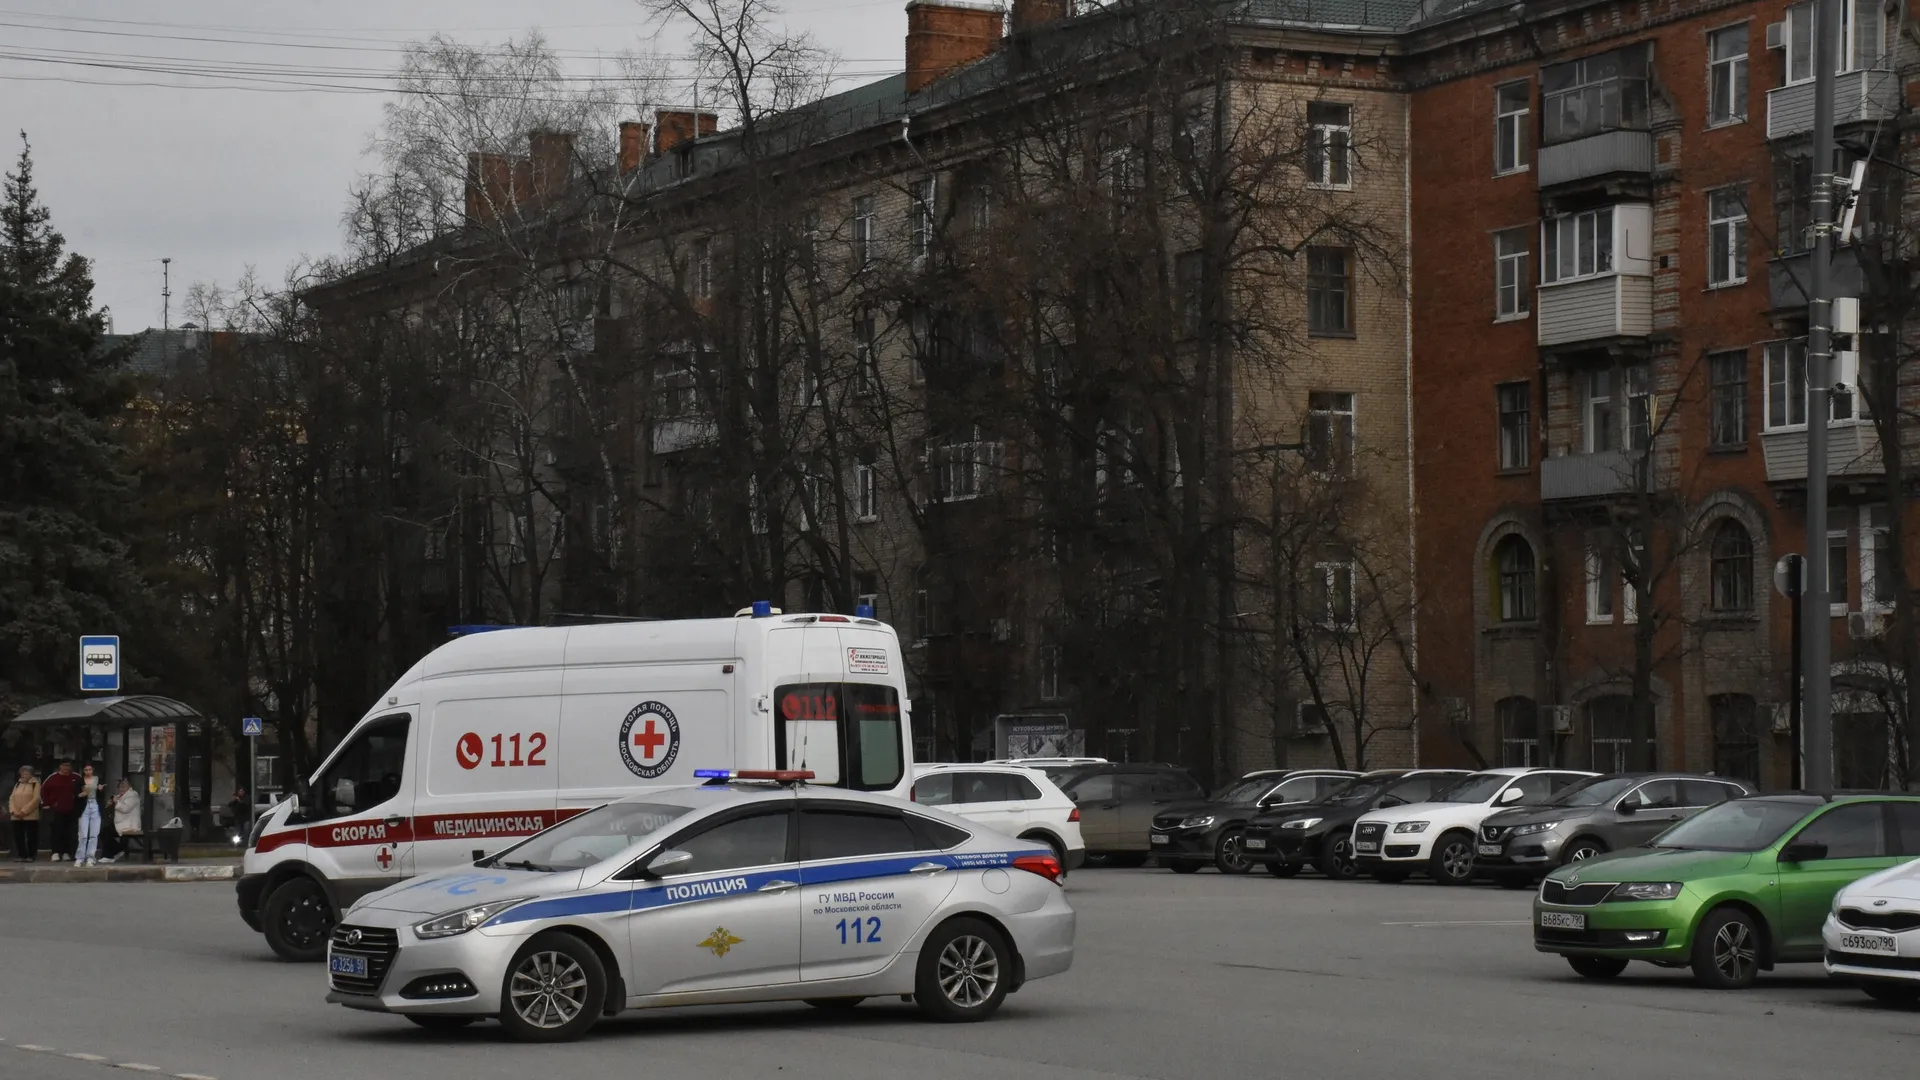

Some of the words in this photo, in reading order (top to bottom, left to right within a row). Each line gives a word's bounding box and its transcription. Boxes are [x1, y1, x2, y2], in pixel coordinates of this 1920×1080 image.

[622, 704, 647, 733] СКОРАЯ
[650, 703, 677, 732] ПОМОЩЬ
[800, 695, 837, 720] 112
[491, 732, 546, 767] 112
[620, 741, 655, 777] МОСКОВСКАЯ
[657, 741, 678, 774] ОБЛАСТЬ
[332, 825, 386, 842] СКОРАЯ
[434, 816, 544, 836] МЕДИЦИНСКАЯ
[666, 878, 747, 900] ПОЛИЦИЯ
[818, 894, 831, 904] ГУ
[833, 892, 857, 903] МВД
[859, 891, 895, 901] России
[824, 904, 870, 914] Московской
[871, 902, 902, 911] области
[835, 916, 882, 945] 112
